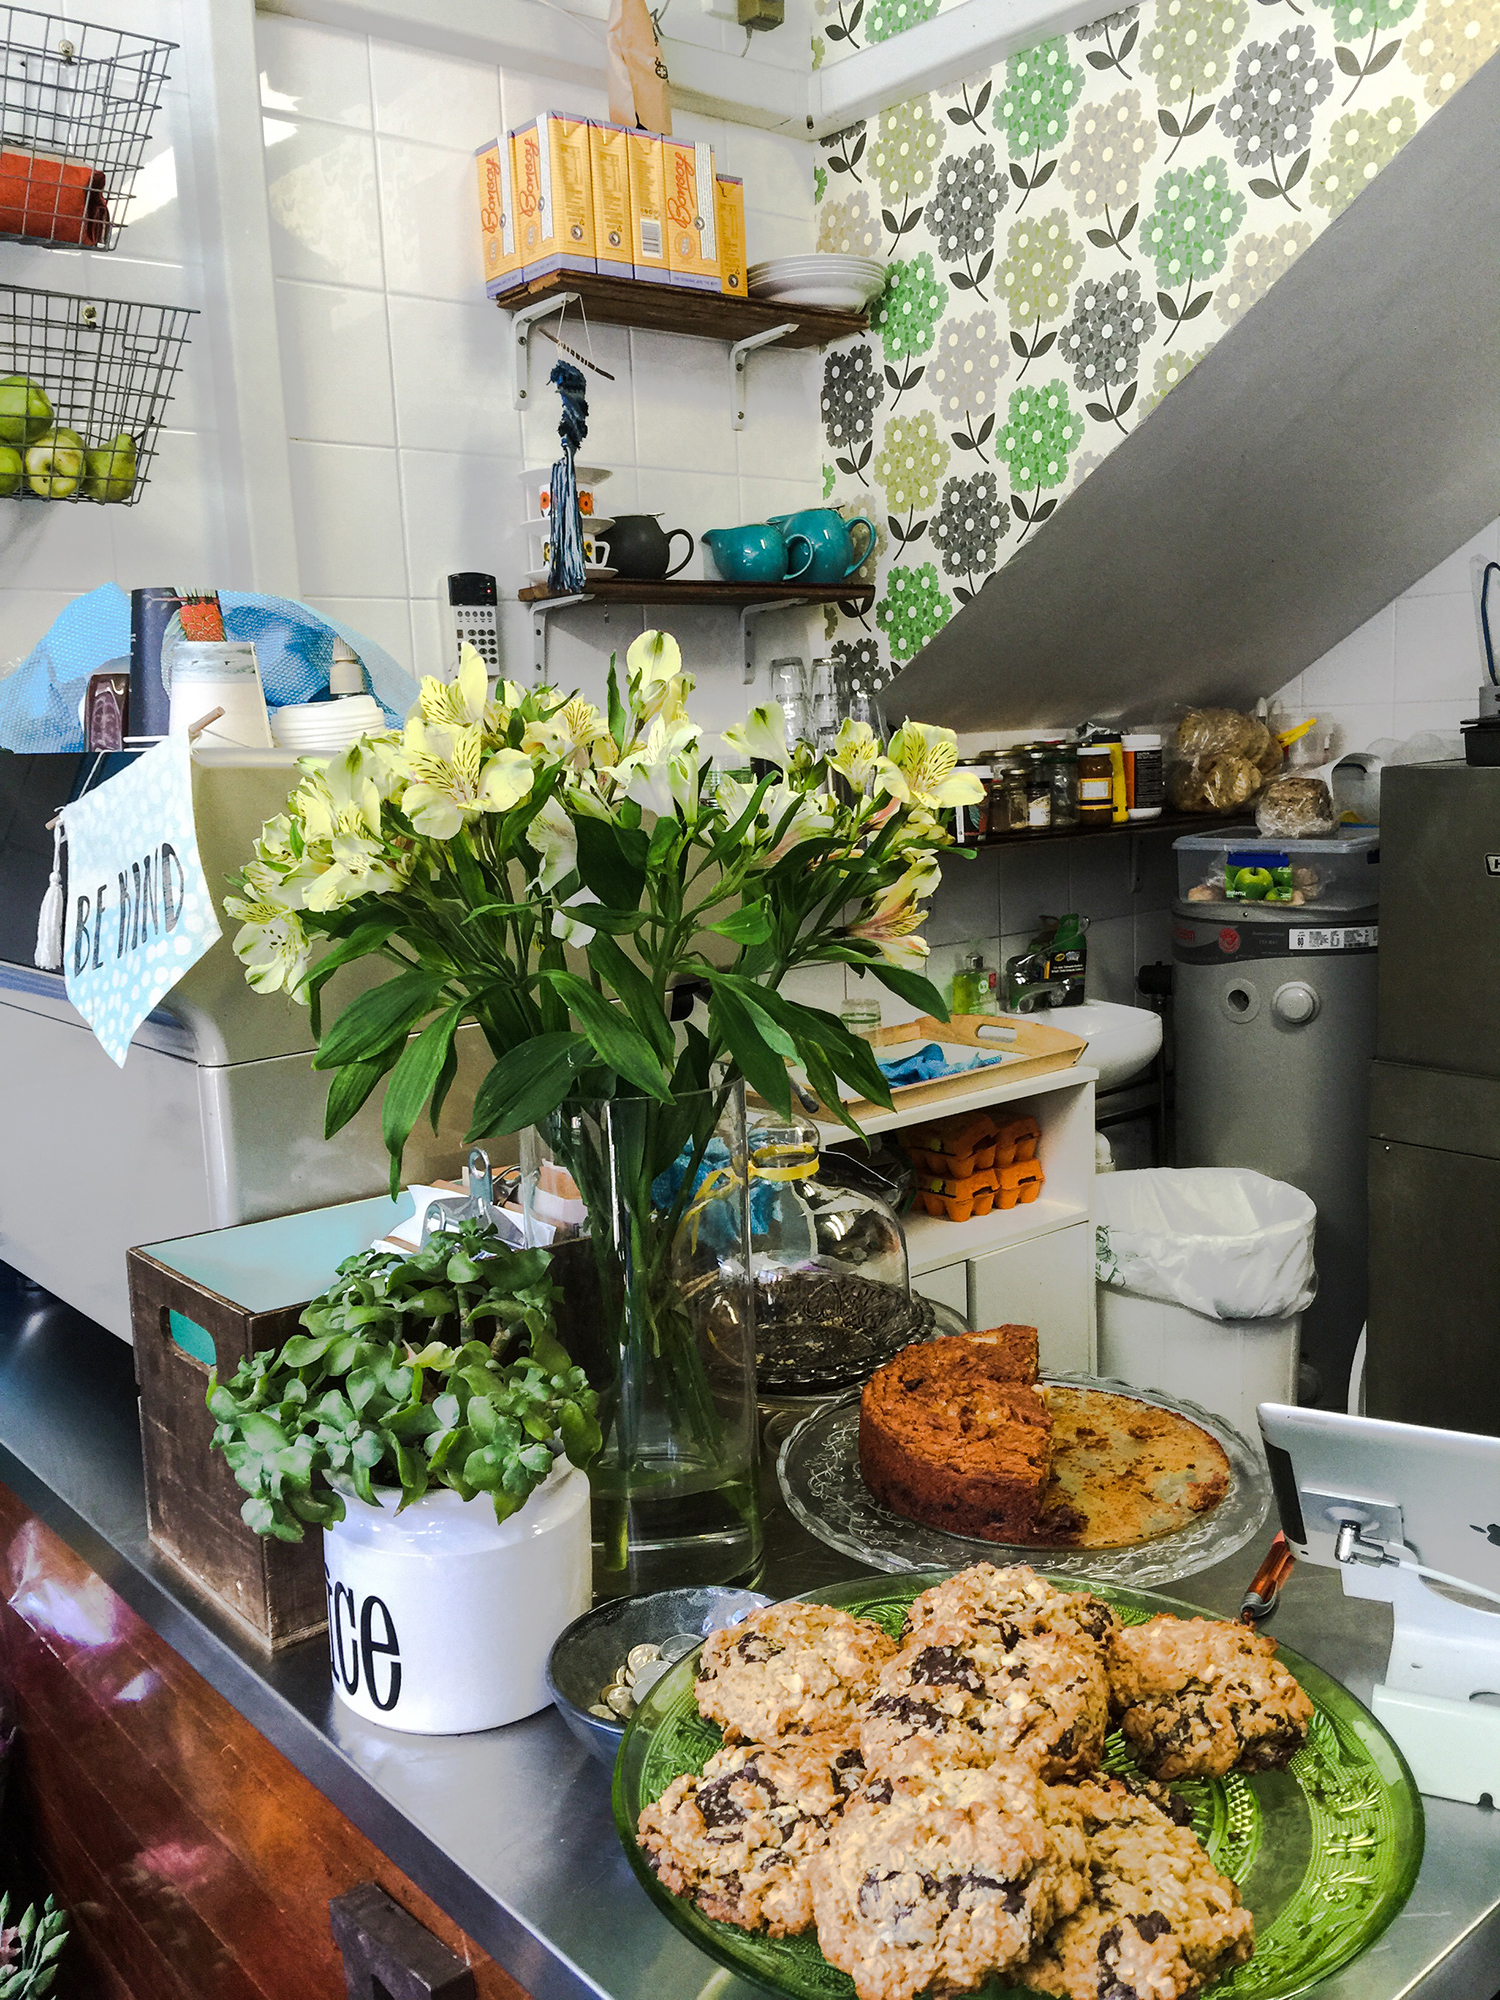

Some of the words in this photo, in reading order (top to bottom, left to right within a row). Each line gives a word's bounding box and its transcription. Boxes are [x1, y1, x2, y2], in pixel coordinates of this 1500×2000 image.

[481, 157, 501, 234] Bonsoy
[519, 137, 539, 218] Bonsoy
[667, 151, 695, 229] Bonsoy
[74, 884, 107, 979] BE
[117, 842, 184, 960] KIND
